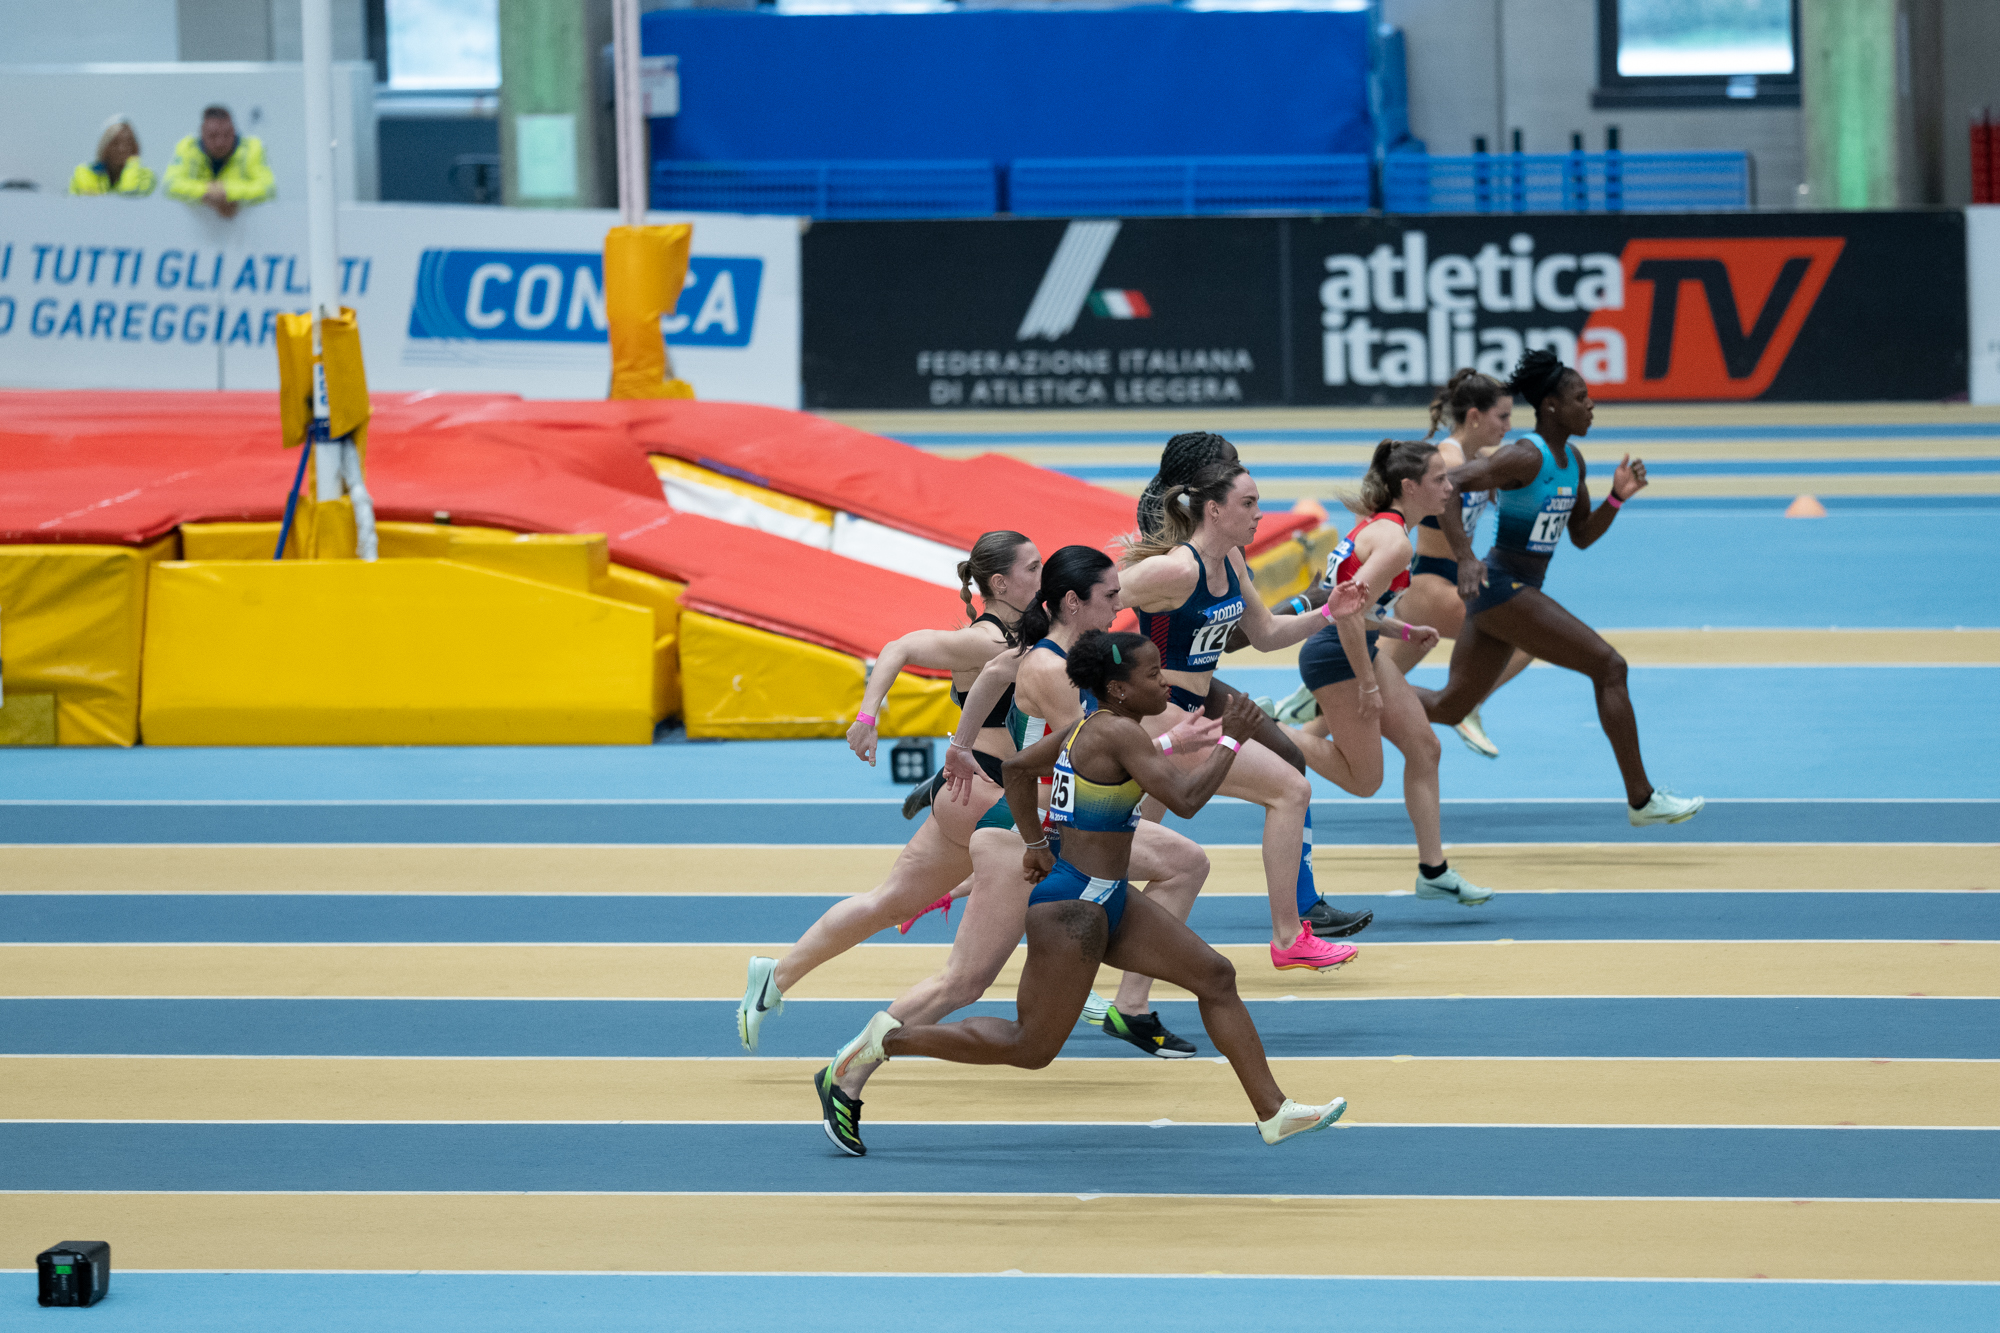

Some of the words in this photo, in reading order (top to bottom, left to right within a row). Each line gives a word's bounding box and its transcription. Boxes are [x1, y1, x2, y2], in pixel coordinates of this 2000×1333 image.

[32, 243, 143, 287] TUTTI
[154, 249, 224, 290] GLI
[233, 253, 372, 296] ATLTI
[1319, 229, 1624, 313] atletica
[29, 297, 312, 346] GAREGGIAR
[1631, 256, 1814, 382] TV
[917, 349, 1111, 377] FEDERAZIONE
[1118, 347, 1254, 374] ITALIANA
[1321, 308, 1627, 387] italiana
[929, 379, 963, 405] DI
[970, 378, 1107, 404] ATLETICA
[1114, 377, 1243, 403] LEGGERA
